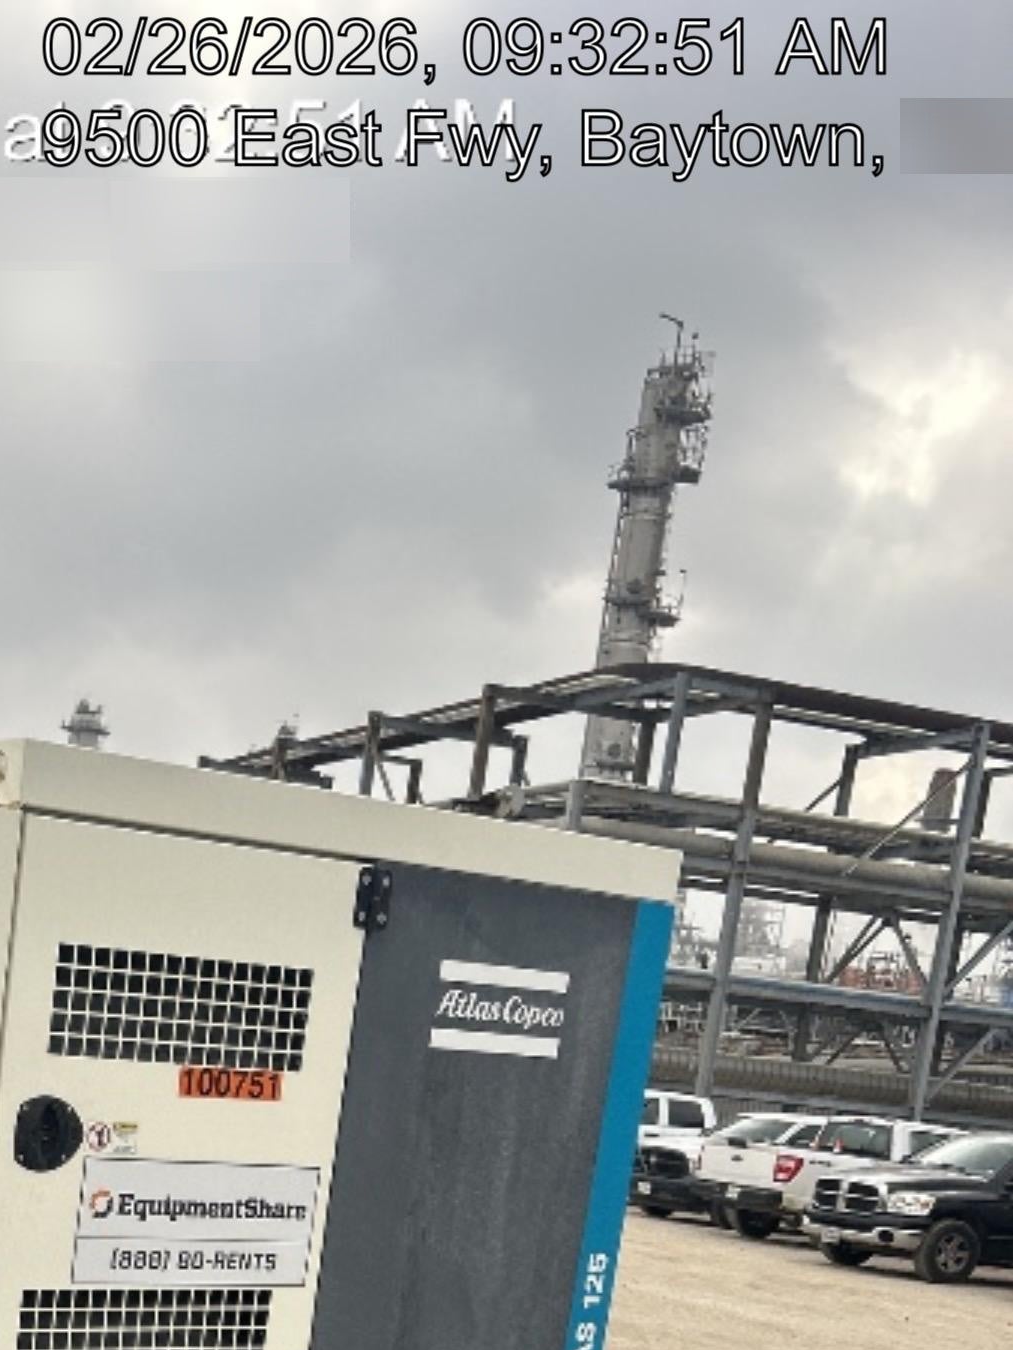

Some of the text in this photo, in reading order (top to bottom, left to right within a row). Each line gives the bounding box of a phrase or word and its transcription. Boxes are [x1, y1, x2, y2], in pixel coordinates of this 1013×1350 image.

[182, 1067, 279, 1099] 100751
[117, 1193, 307, 1222] EquipmentShare
[583, 1252, 610, 1310] 125
